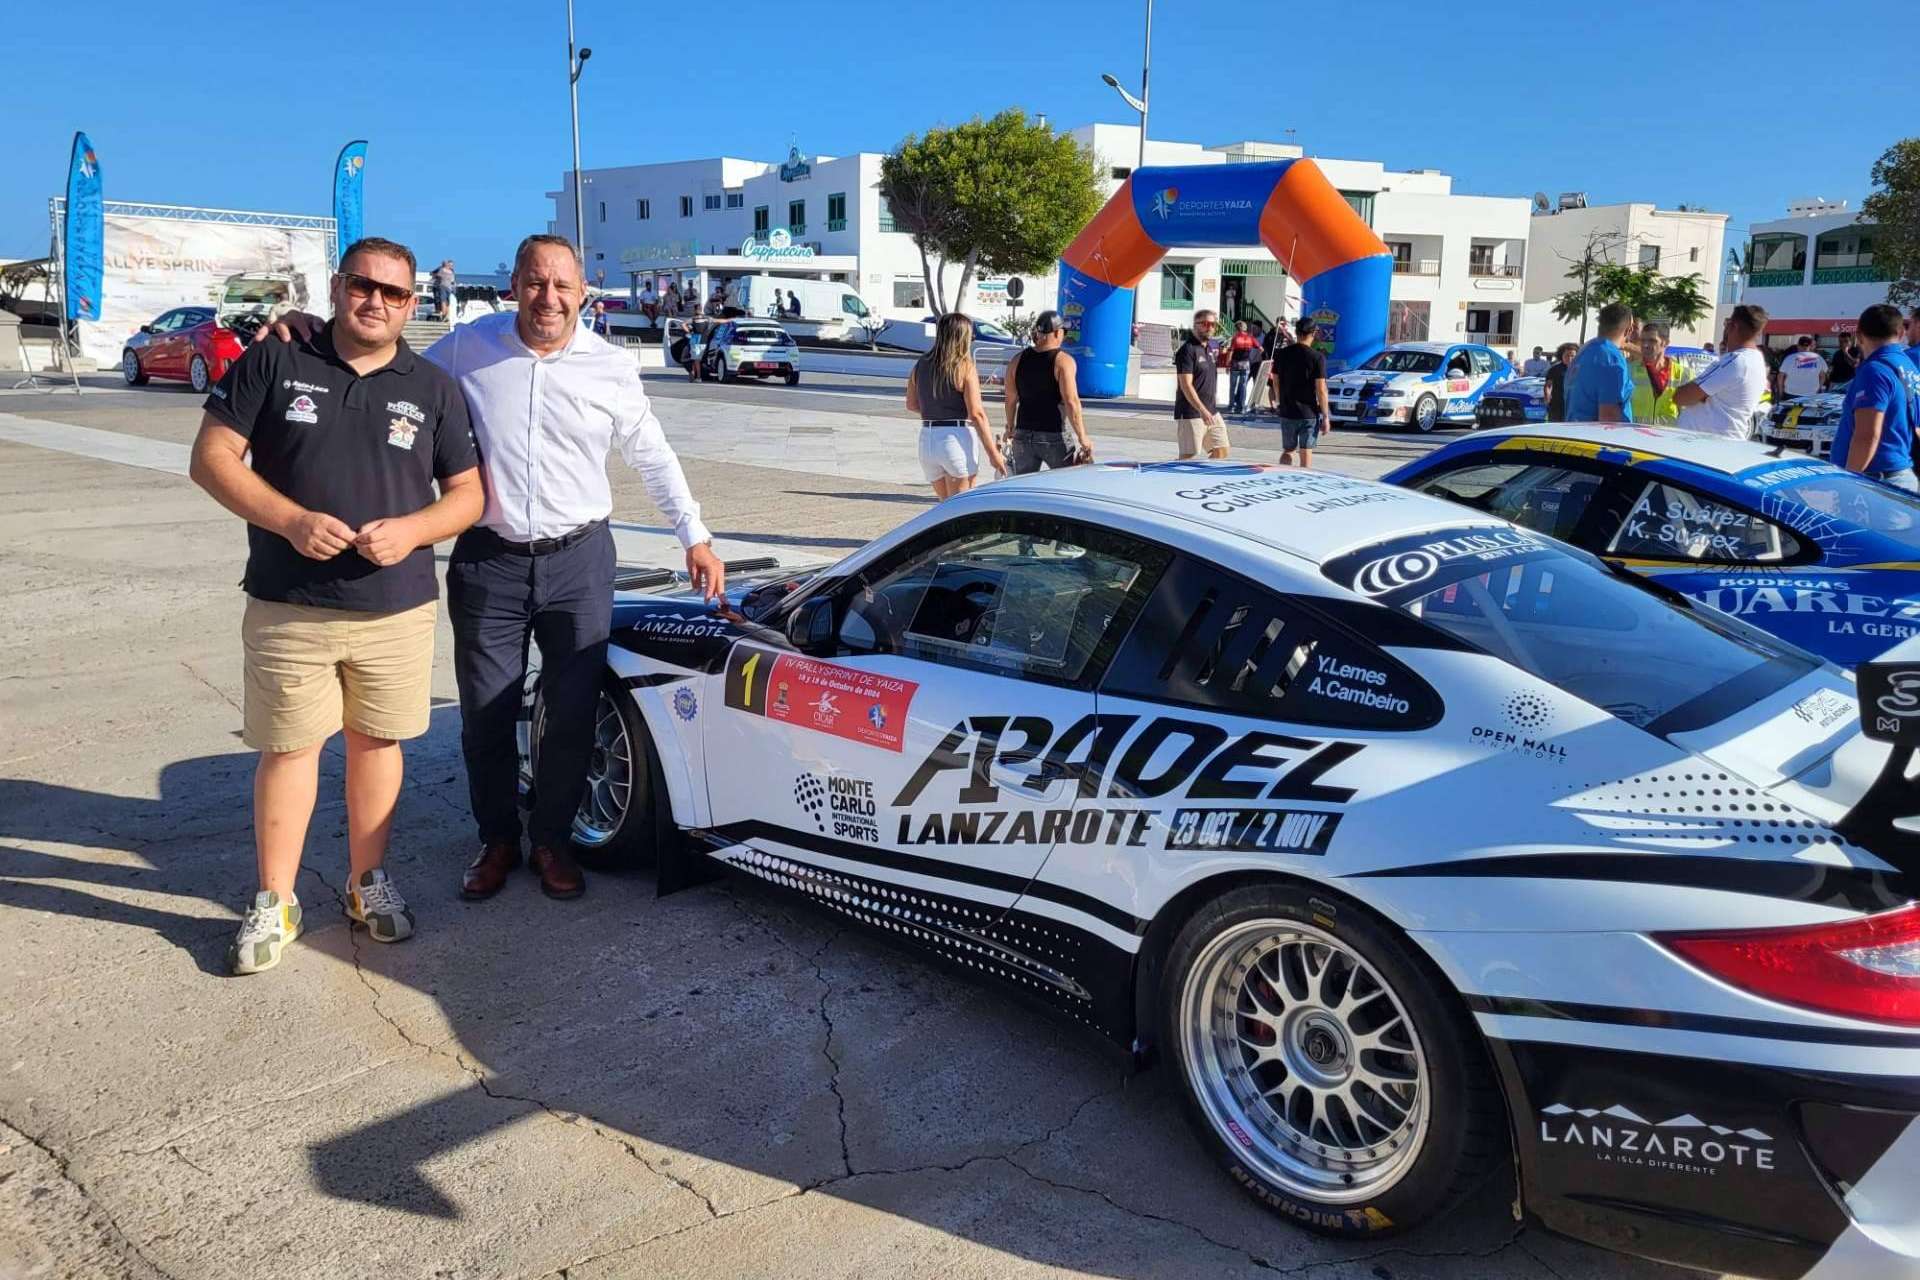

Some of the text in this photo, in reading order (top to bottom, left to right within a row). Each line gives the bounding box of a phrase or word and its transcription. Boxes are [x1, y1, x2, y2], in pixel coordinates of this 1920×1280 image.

[741, 236, 814, 261] Cappuccino
[103, 255, 219, 273] ALLYE SPRIN
[1201, 487, 1305, 513] Cultura
[1635, 498, 1656, 517] A.
[1666, 502, 1747, 528] Suárez
[1420, 534, 1500, 560] PLUS
[1628, 520, 1741, 551] K. Suárez
[1719, 578, 1850, 591] BODEGAS
[1682, 587, 1920, 622] UAREZ
[633, 620, 725, 637] LANZAROTE
[1828, 620, 1856, 634] LA
[742, 653, 760, 706] 1
[1318, 655, 1388, 686] Y.Lemes
[859, 675, 874, 685] DE
[876, 680, 904, 693] YAIZA
[1307, 676, 1410, 713] A.Cambeiro
[1468, 735, 1565, 764] LANZAROTE
[1472, 727, 1567, 757] OPEN MALL
[828, 776, 873, 798] MONTE
[830, 794, 876, 817] CARLO
[832, 812, 878, 827] INTERNATIONAL
[834, 822, 879, 842] SPORTS
[896, 808, 1163, 847] LANZAROTE
[1172, 811, 1200, 845] 23
[1199, 811, 1240, 846] OCT
[1255, 812, 1277, 847] 2
[1274, 813, 1328, 849] NOV
[1541, 1121, 1775, 1170] LANZAROTE
[1597, 1153, 1717, 1175] LA ISLA DIFERENTE
[1230, 1166, 1343, 1229] MICHELIN
